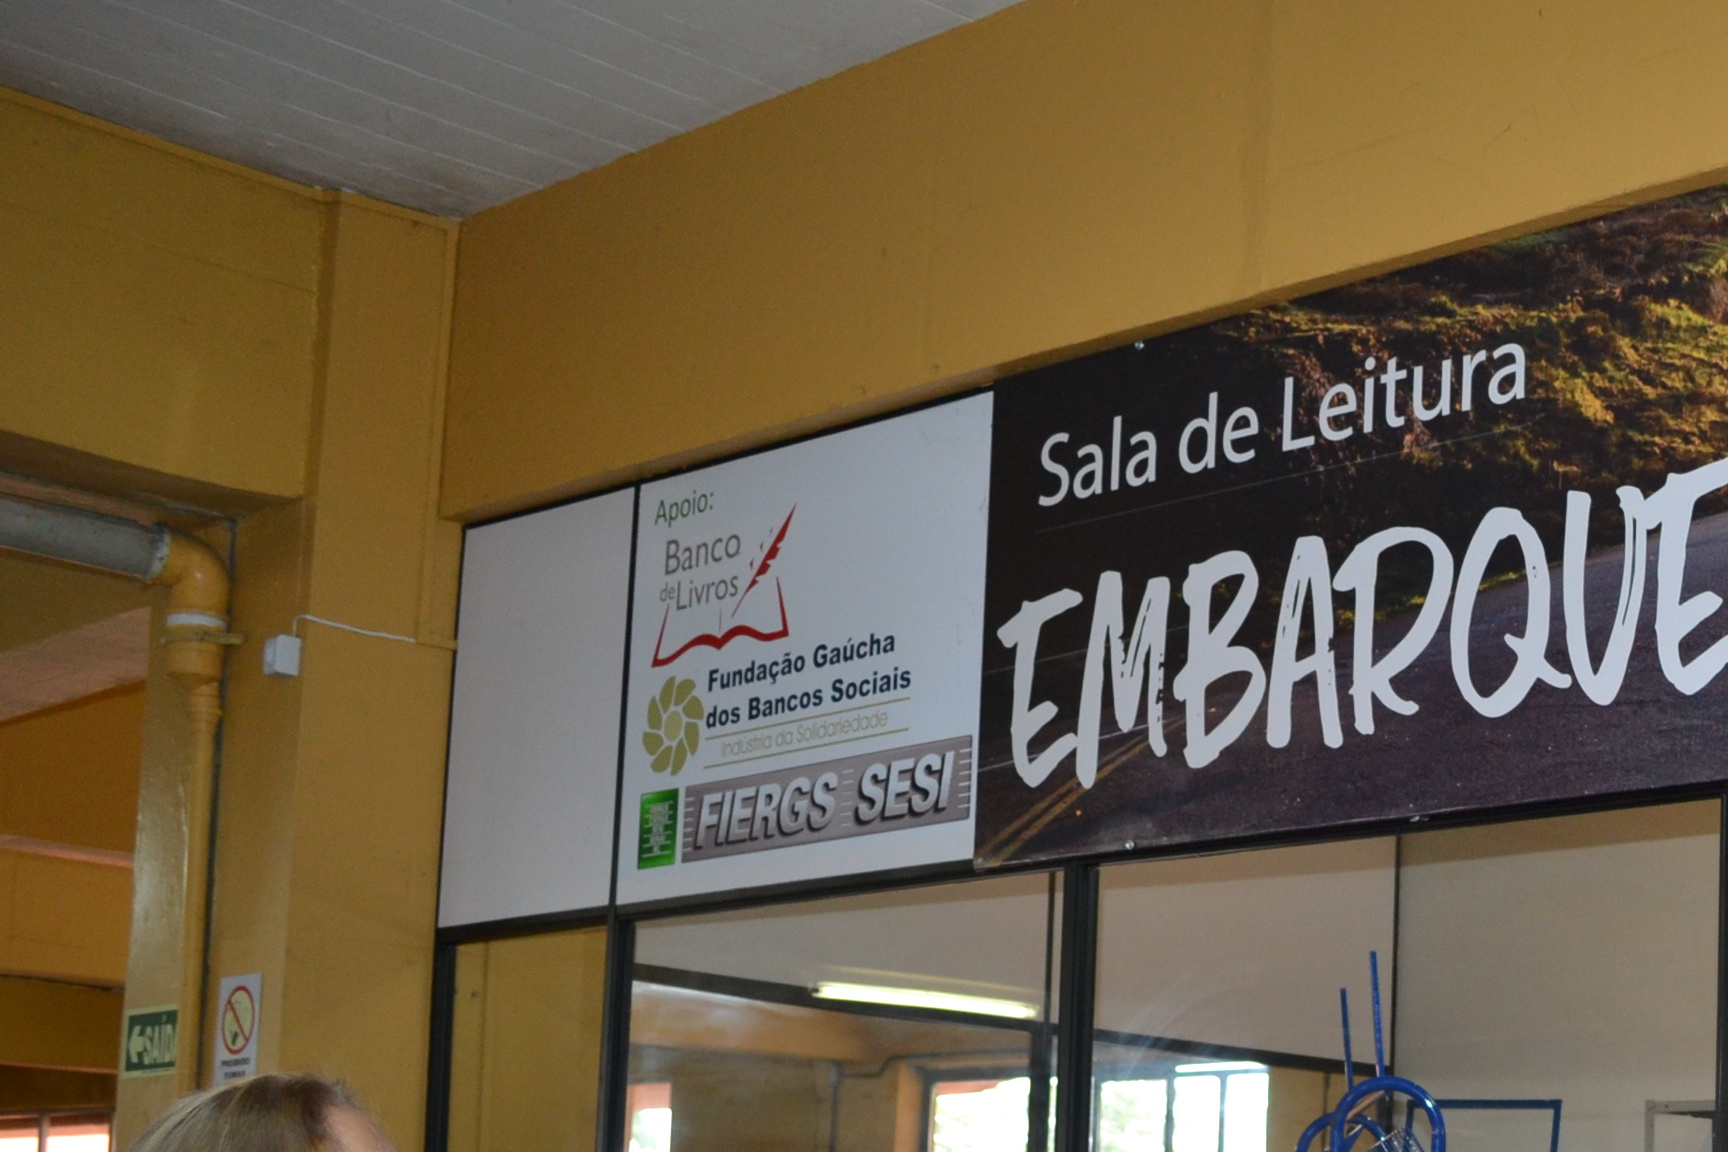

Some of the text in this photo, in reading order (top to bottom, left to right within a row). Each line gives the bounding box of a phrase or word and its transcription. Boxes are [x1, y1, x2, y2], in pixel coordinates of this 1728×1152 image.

[1037, 342, 1528, 507] Sala de Leitura
[654, 490, 714, 528] Apoio:
[665, 534, 741, 576] Banco
[659, 575, 738, 611] de Livros
[708, 633, 895, 692] Fundação Gaúcha
[706, 667, 911, 729] dos Bancos Sociais
[721, 710, 888, 758] Indústria da Solidariedade
[694, 771, 839, 850] FIERGS
[853, 749, 956, 828] SESI
[143, 1014, 174, 1065] SAÍD
